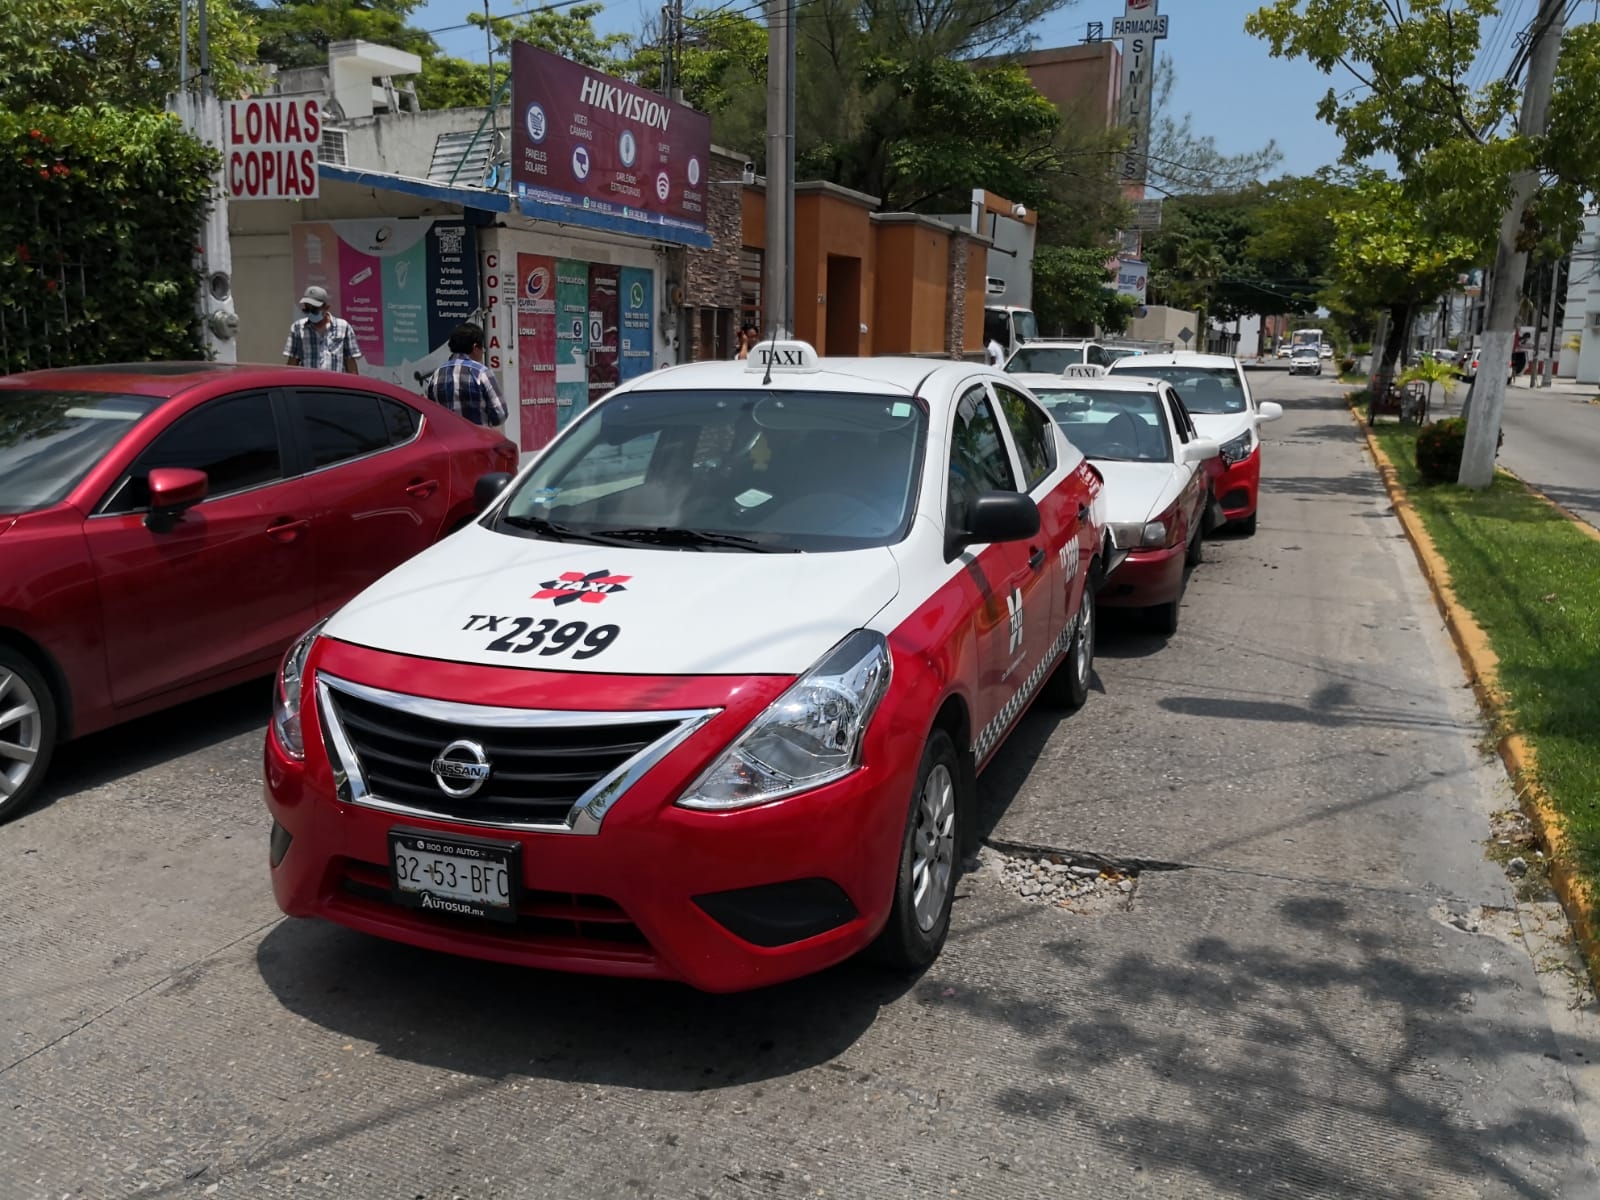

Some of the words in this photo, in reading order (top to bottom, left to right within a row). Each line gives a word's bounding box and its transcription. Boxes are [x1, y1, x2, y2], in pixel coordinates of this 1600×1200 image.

[1114, 19, 1165, 35] FARMACIAS
[580, 75, 671, 132] HIKVISION
[230, 100, 320, 145] LONAS
[525, 147, 548, 162] PANELES
[230, 149, 316, 196] COPIAS
[525, 160, 548, 175] SOLARES
[486, 254, 501, 369] COPIAS
[519, 328, 536, 336] LONAS
[758, 349, 803, 366] TAXI
[1069, 368, 1096, 378] TAXI
[553, 580, 615, 593] TAXI
[1010, 608, 1023, 634] TAXI
[434, 762, 482, 776] NISSAN
[426, 843, 442, 852] 800
[456, 848, 480, 857] AUTOS
[397, 856, 509, 897] 32-53-BFC
